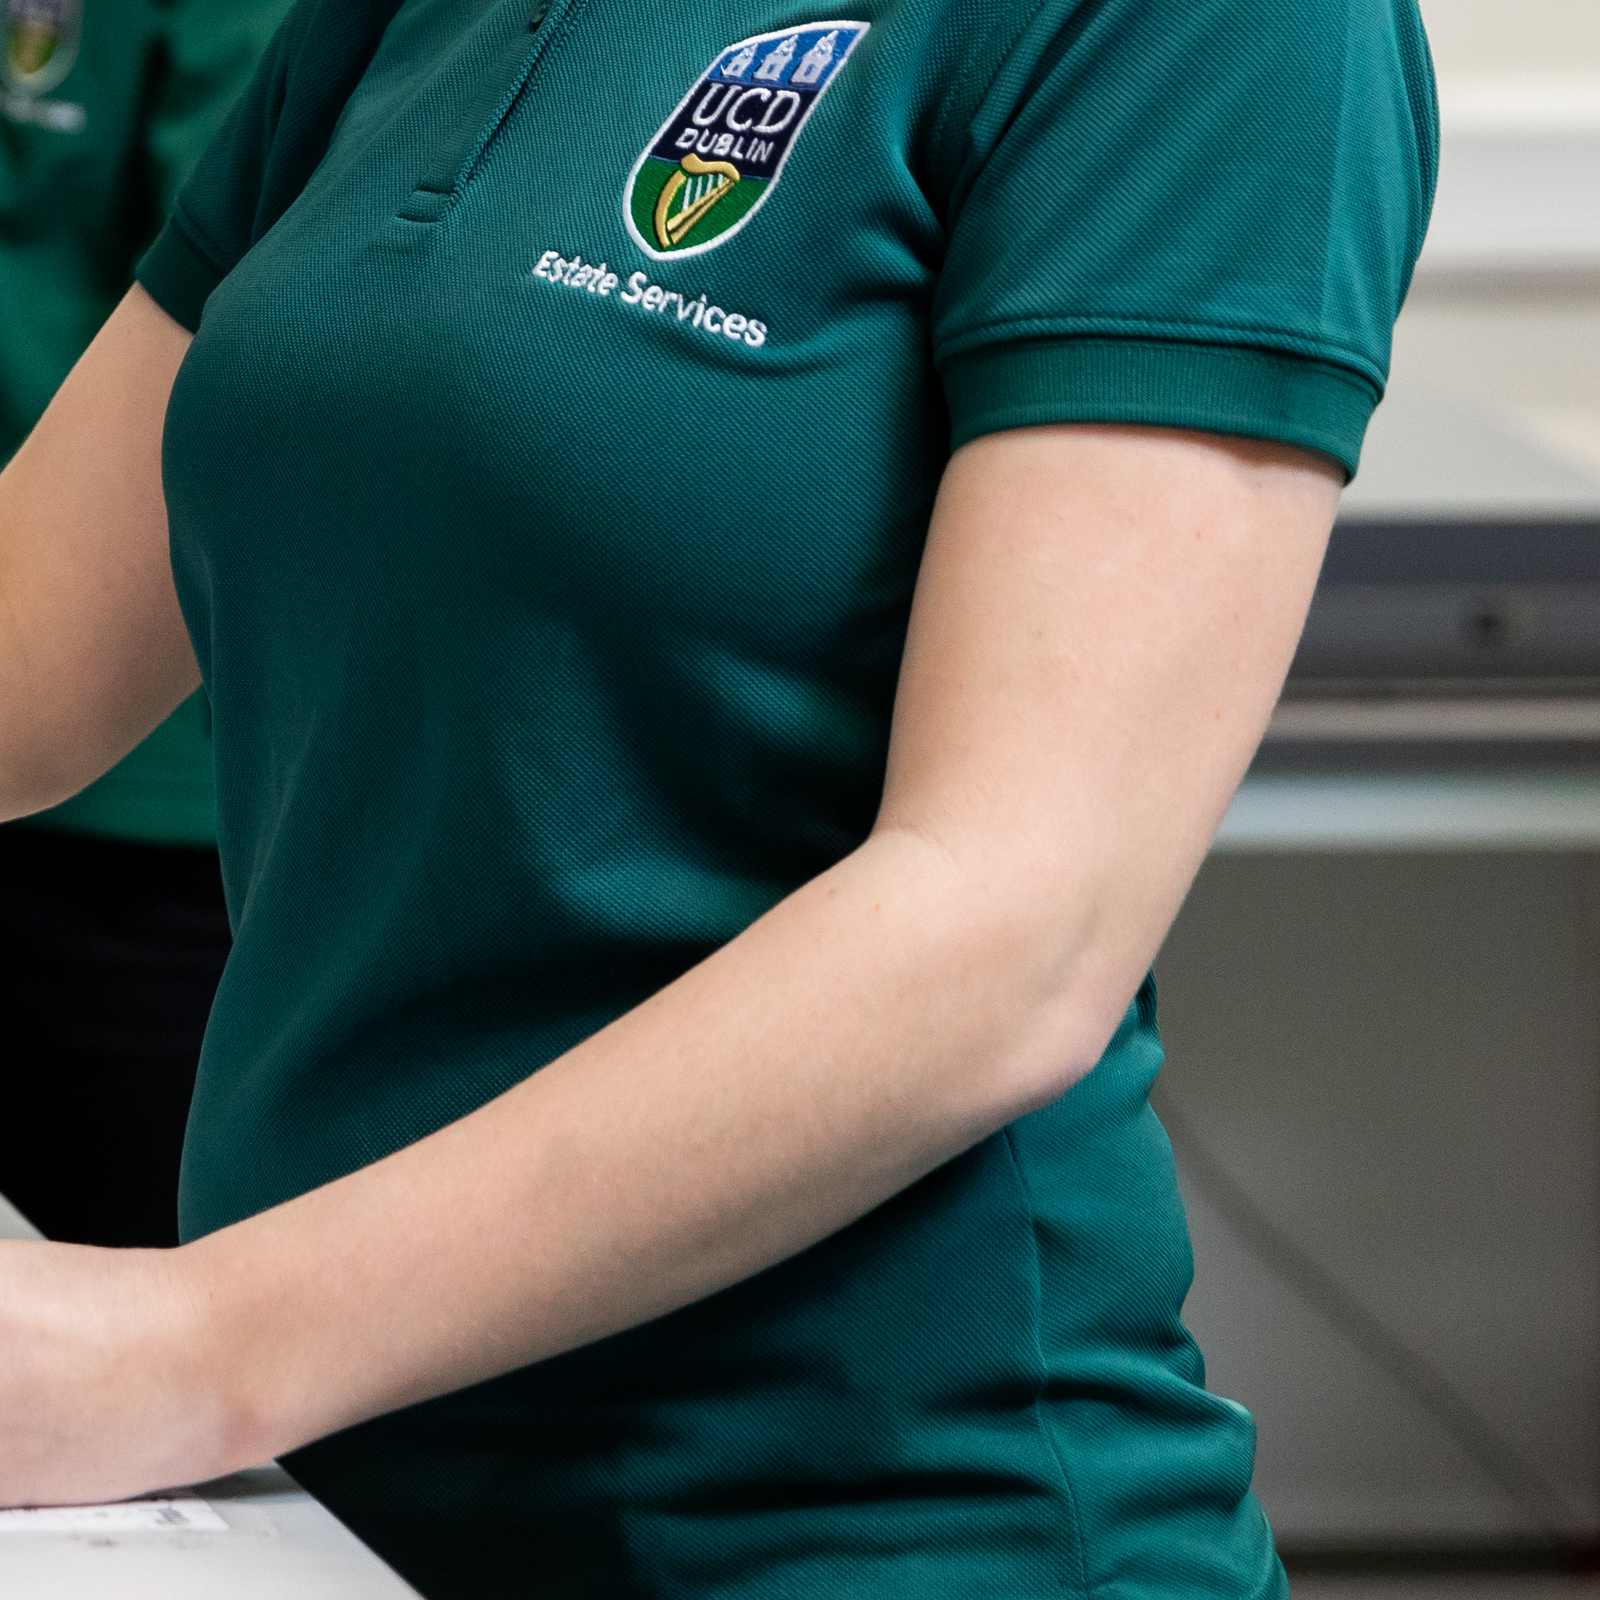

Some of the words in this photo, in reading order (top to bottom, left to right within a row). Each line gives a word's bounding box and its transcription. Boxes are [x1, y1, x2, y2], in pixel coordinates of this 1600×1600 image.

[692, 82, 801, 134] UCD
[675, 127, 775, 163] DUBLIN
[532, 250, 619, 296] Estate
[620, 271, 768, 348] Services
